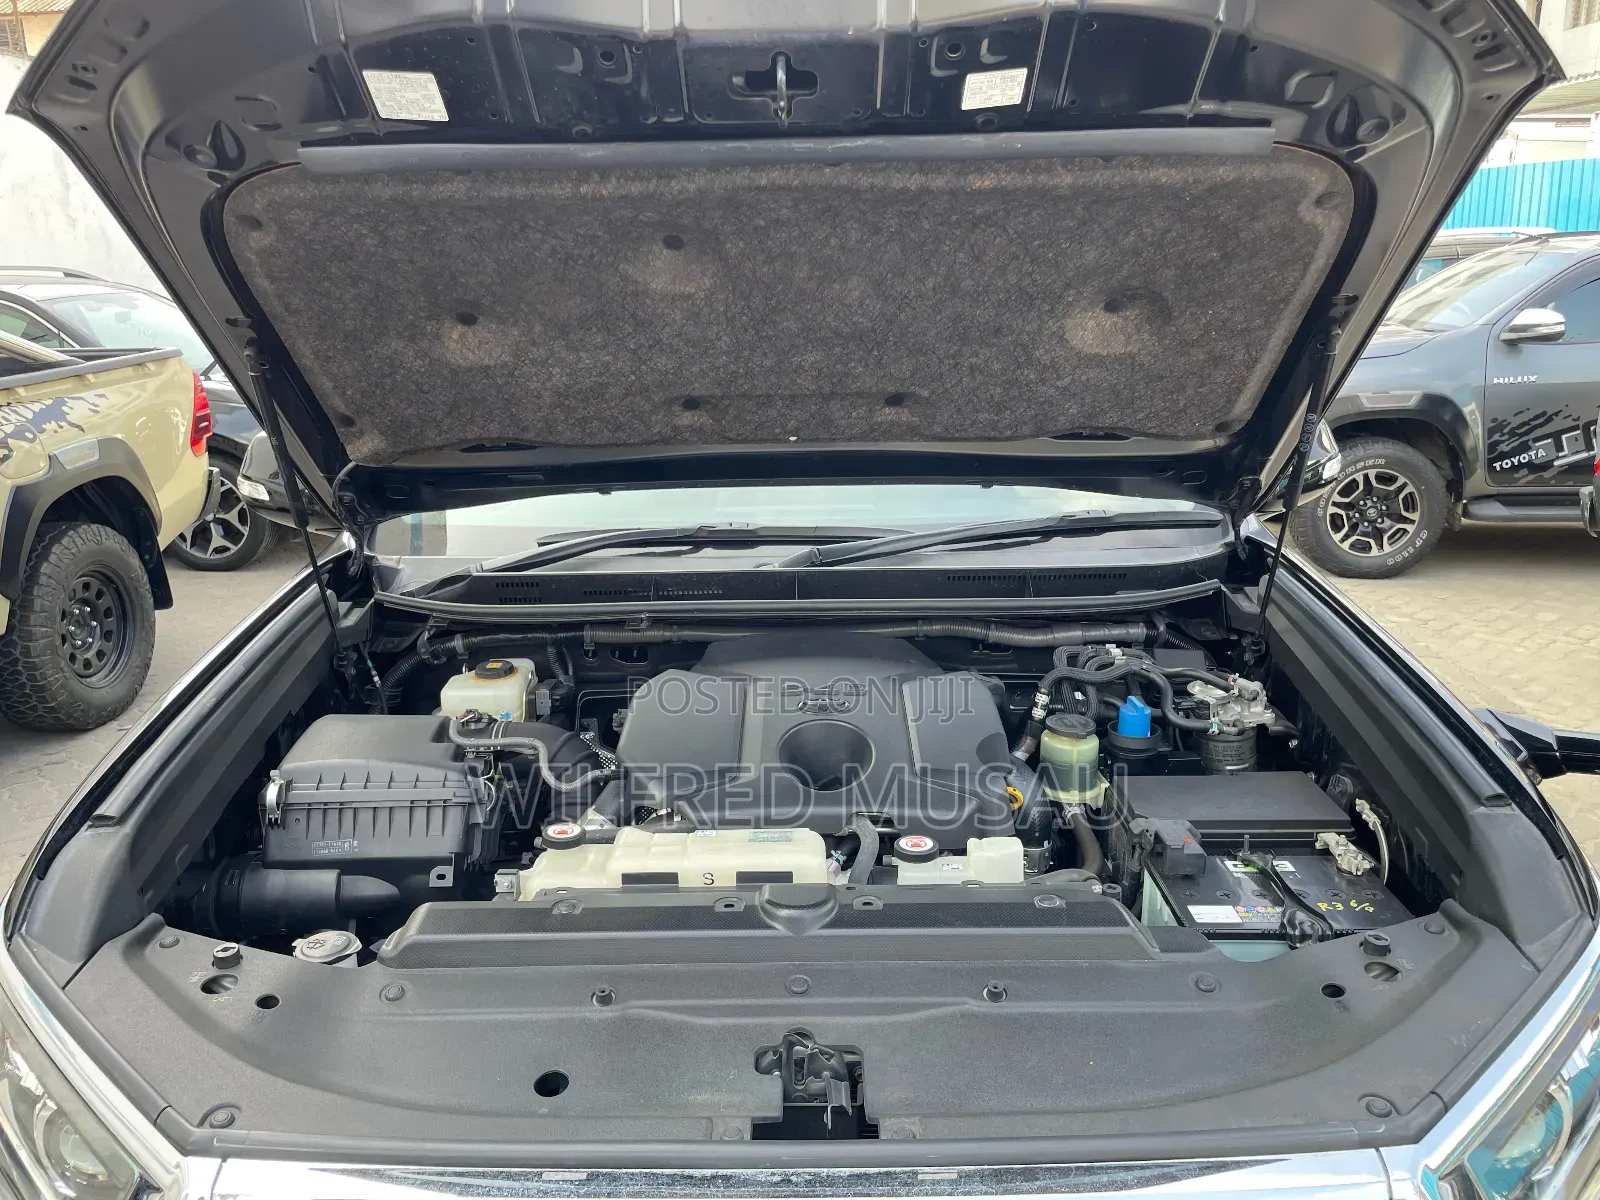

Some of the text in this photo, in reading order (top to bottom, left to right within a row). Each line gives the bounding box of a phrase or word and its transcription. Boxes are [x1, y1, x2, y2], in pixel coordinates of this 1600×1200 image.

[1493, 375, 1538, 384] HILUX
[1493, 448, 1547, 472] TOYOTA
[702, 872, 715, 886] S
